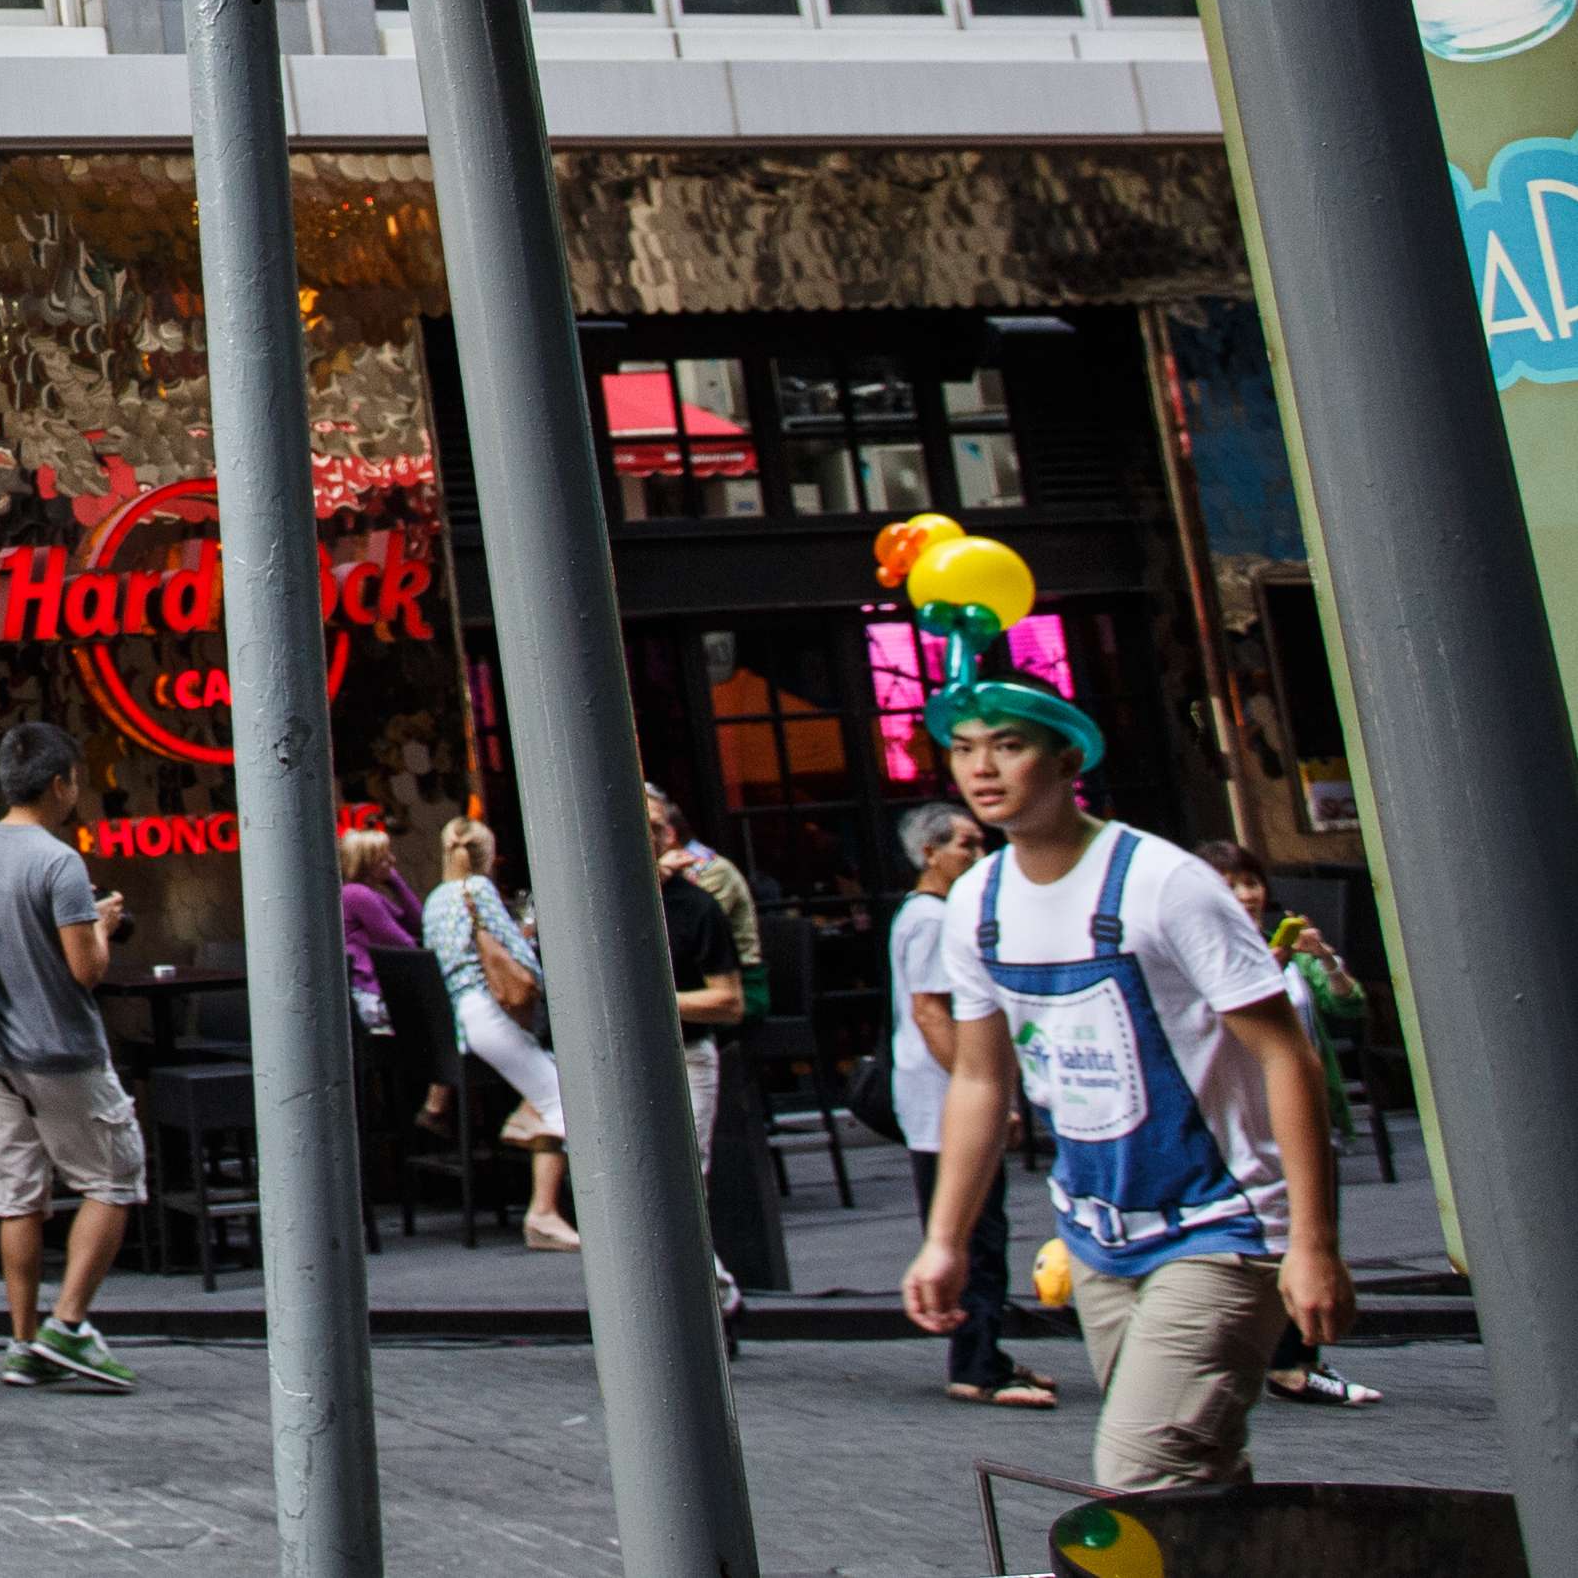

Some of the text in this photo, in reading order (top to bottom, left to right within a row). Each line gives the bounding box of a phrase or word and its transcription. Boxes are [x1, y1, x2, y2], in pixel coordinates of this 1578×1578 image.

[2, 531, 435, 640] Hard ck
[173, 668, 233, 710] CA
[97, 812, 239, 859] HONG
